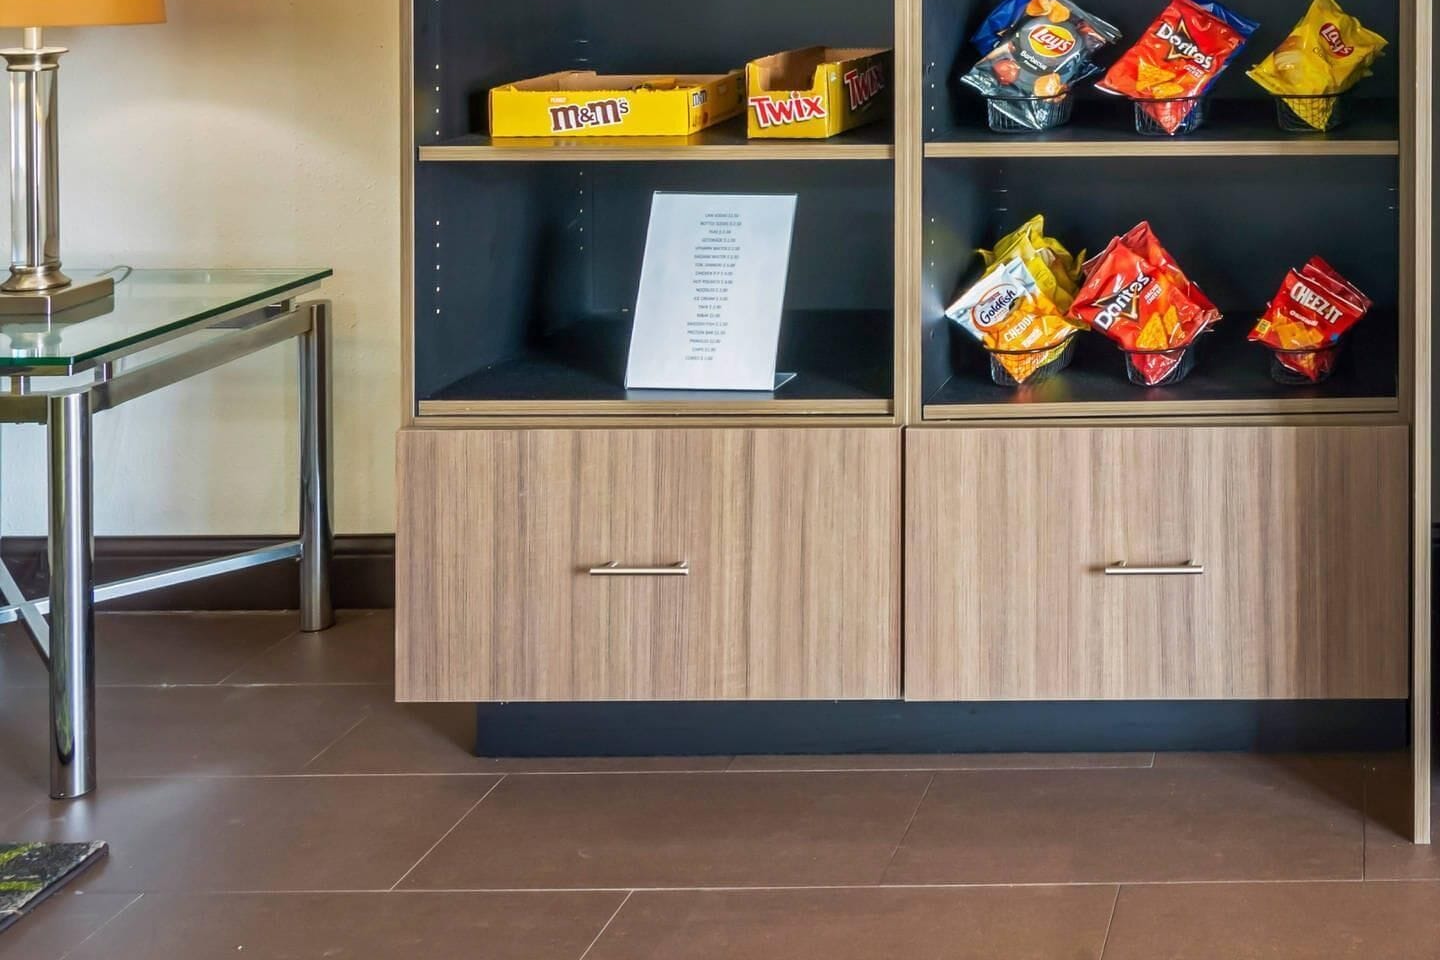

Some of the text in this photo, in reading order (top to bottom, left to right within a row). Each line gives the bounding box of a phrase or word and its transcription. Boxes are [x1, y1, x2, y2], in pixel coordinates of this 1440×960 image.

[1156, 23, 1213, 69] Doritos
[980, 288, 1017, 325] Goldfish
[1093, 275, 1150, 330] Doritos
